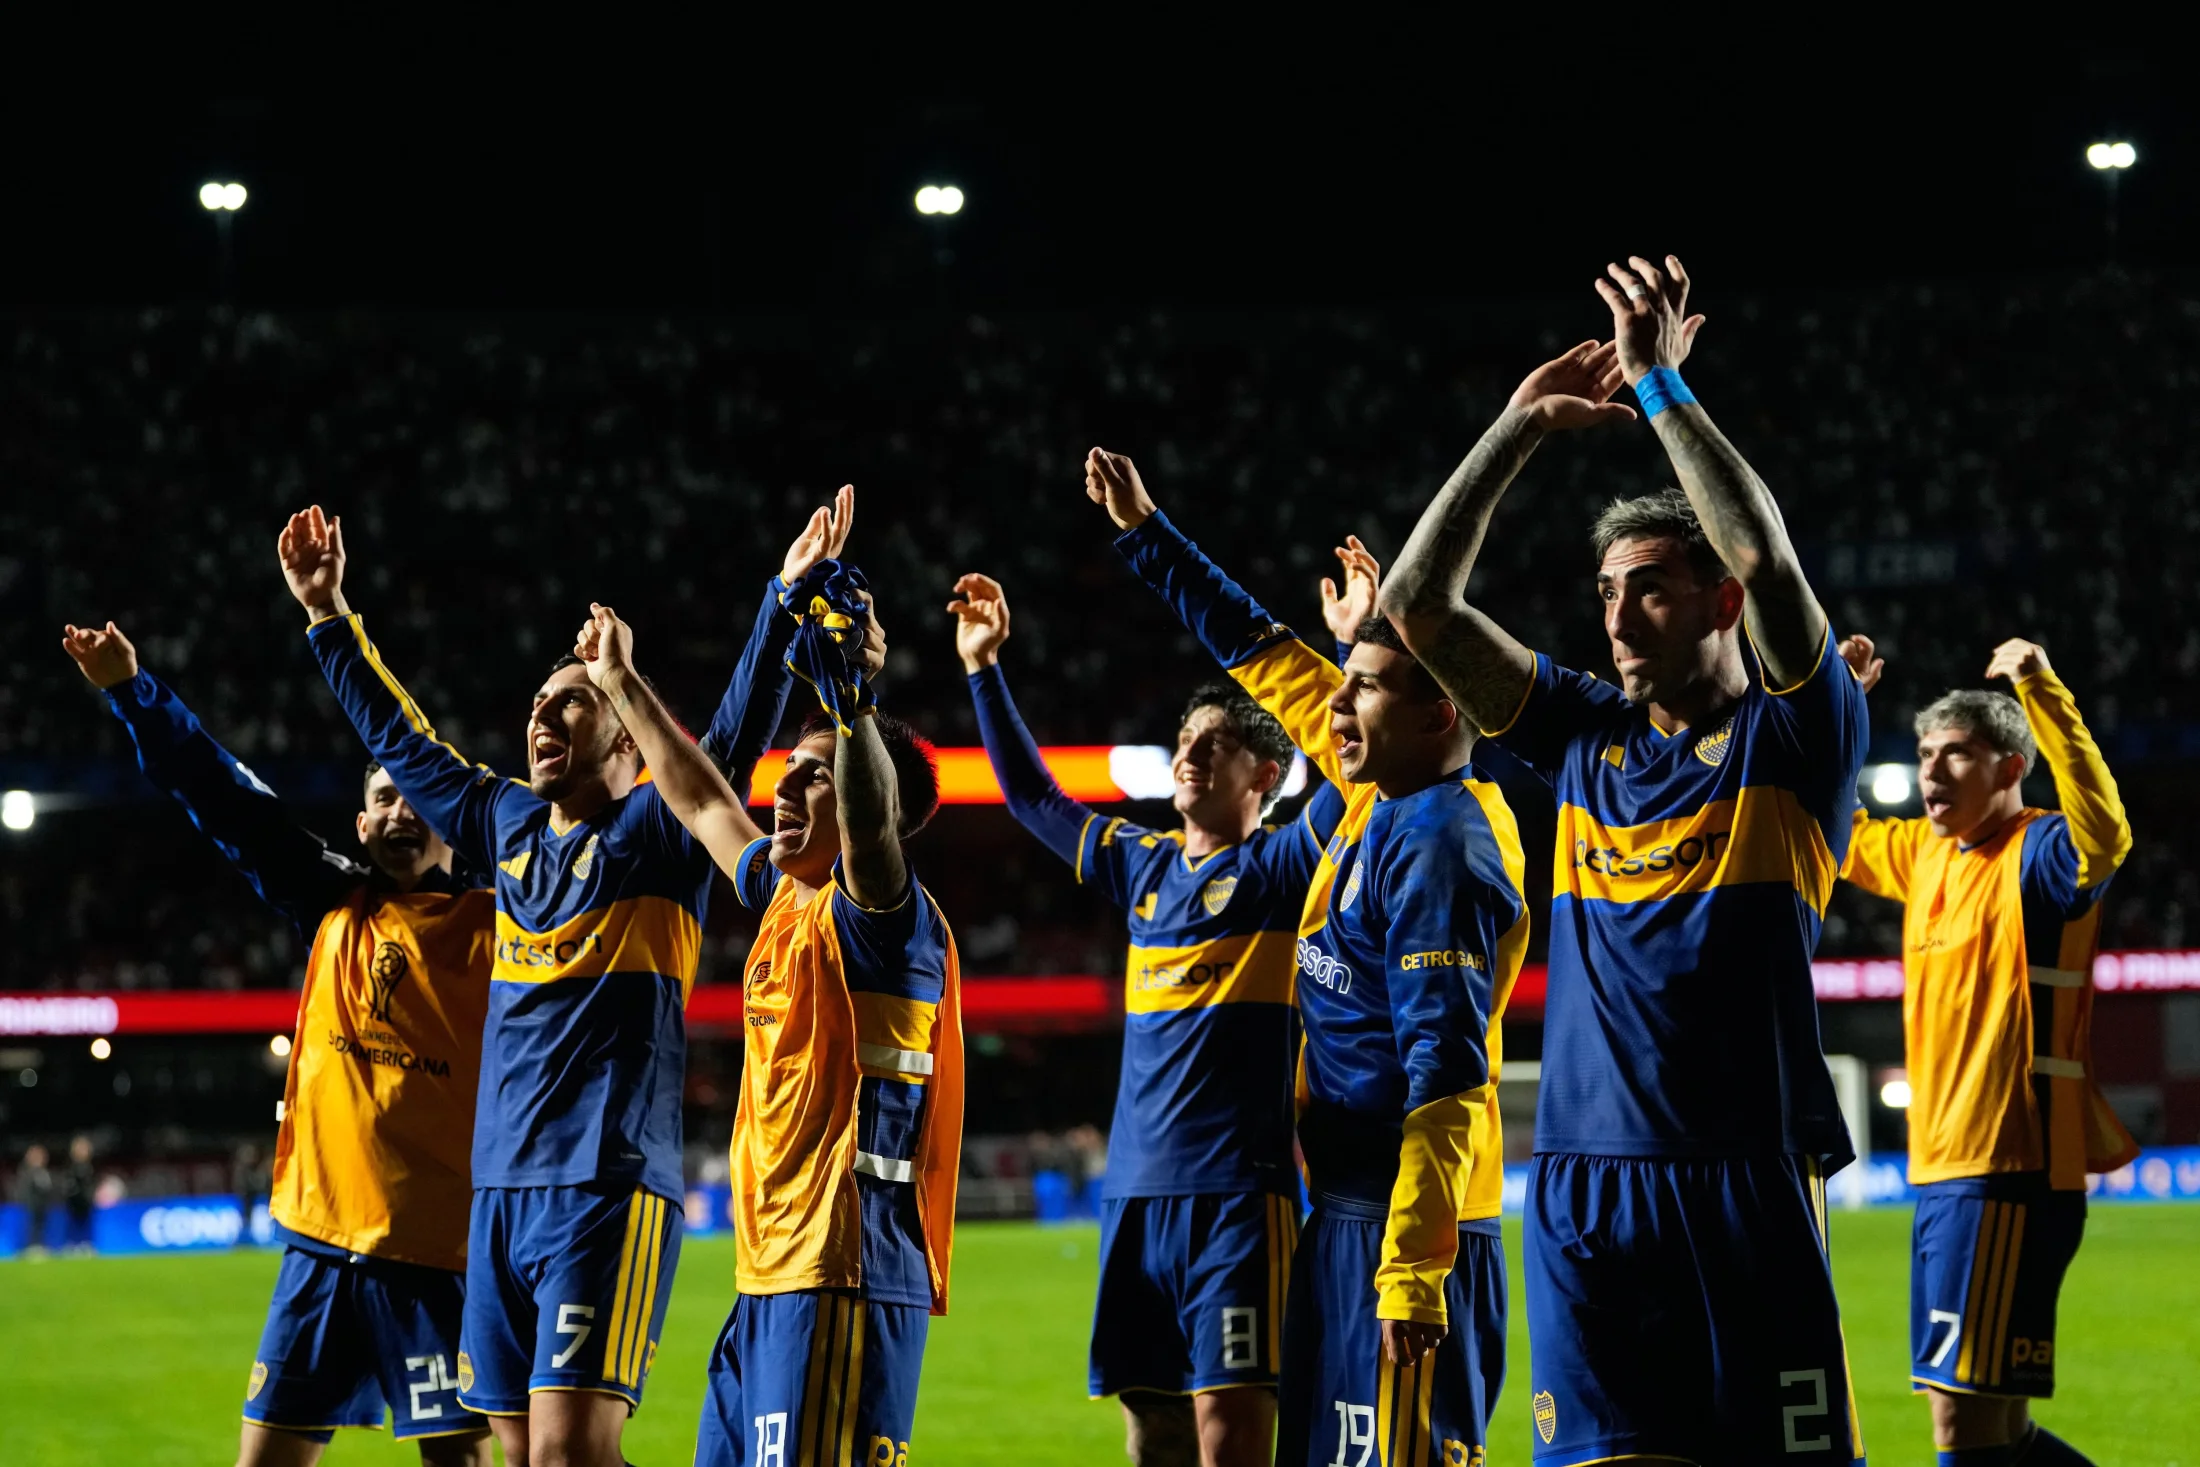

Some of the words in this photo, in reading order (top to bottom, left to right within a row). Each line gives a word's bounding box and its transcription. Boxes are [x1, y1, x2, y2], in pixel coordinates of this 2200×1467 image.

[1401, 949, 1486, 971] CETROGAR
[552, 1303, 595, 1369] 5
[1222, 1306, 1259, 1369] 8
[1929, 1308, 1961, 1368] 7
[1327, 1400, 1375, 1467] 19
[1779, 1367, 1832, 1453] 2
